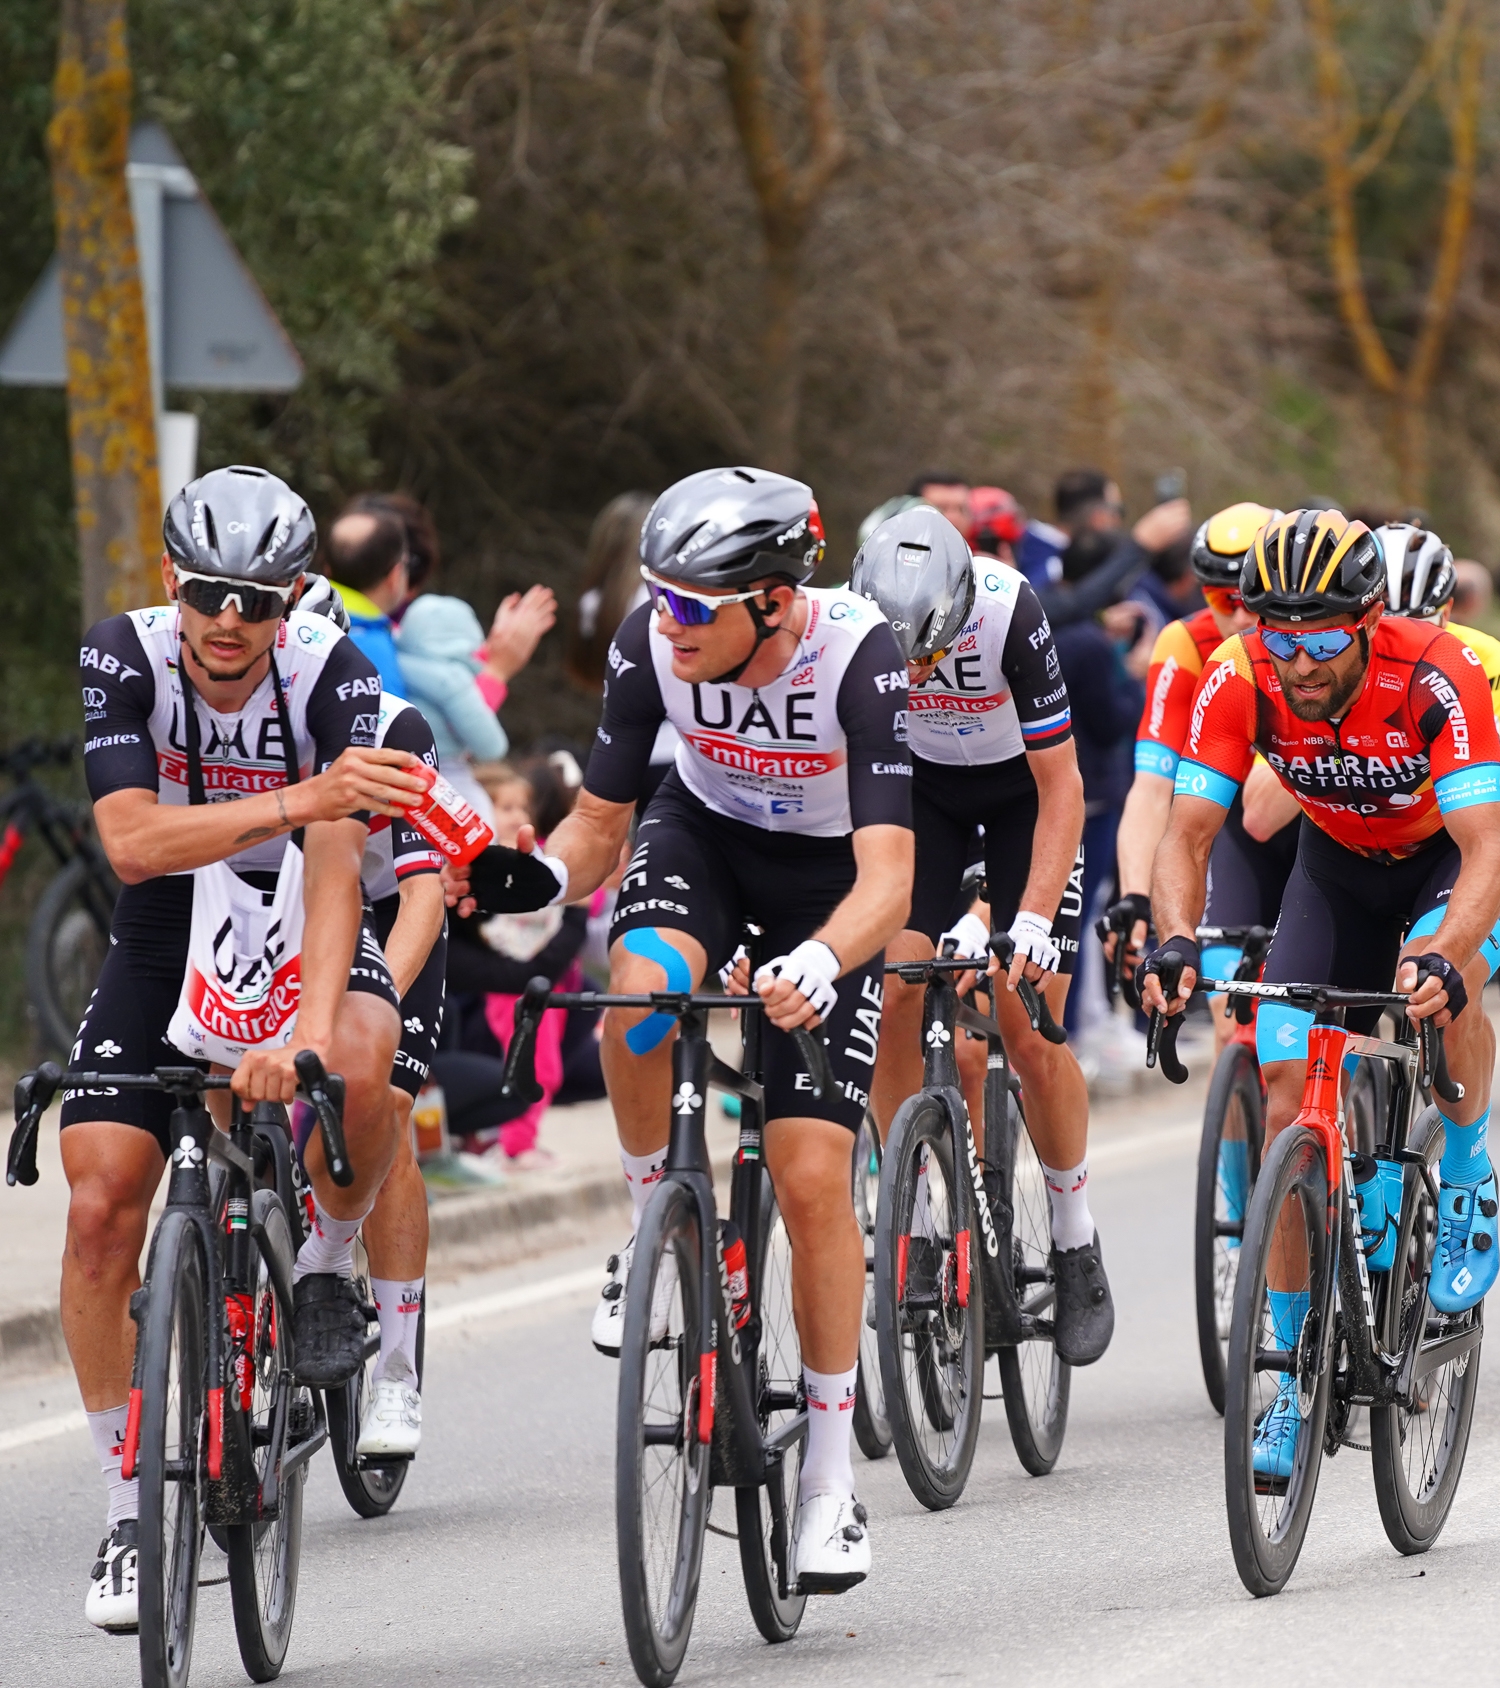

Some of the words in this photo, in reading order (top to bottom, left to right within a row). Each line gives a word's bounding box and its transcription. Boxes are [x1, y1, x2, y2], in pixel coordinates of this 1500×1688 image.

[191, 499, 210, 551] MET
[676, 519, 717, 565] MET
[776, 517, 808, 547] MET
[984, 573, 1012, 594] G42
[1361, 574, 1386, 605] RUDY
[297, 625, 327, 645] G42
[892, 620, 911, 632] G42
[925, 605, 946, 649] MET
[916, 654, 987, 691] AE
[692, 682, 817, 742] UAE
[908, 696, 999, 712] mirates
[1189, 658, 1237, 755] MERIDA
[1419, 671, 1470, 761] MERIDA
[84, 733, 140, 755] mirates
[169, 701, 289, 761] UAE
[1303, 736, 1324, 745] NBB
[693, 738, 828, 777] Emirates
[1268, 752, 1430, 776] BAHRAIN
[1442, 790, 1472, 804] Salam
[1473, 785, 1497, 796] Bank
[1060, 843, 1085, 918] UAE
[200, 973, 302, 1041] Emirates
[844, 975, 884, 1066] UAE
